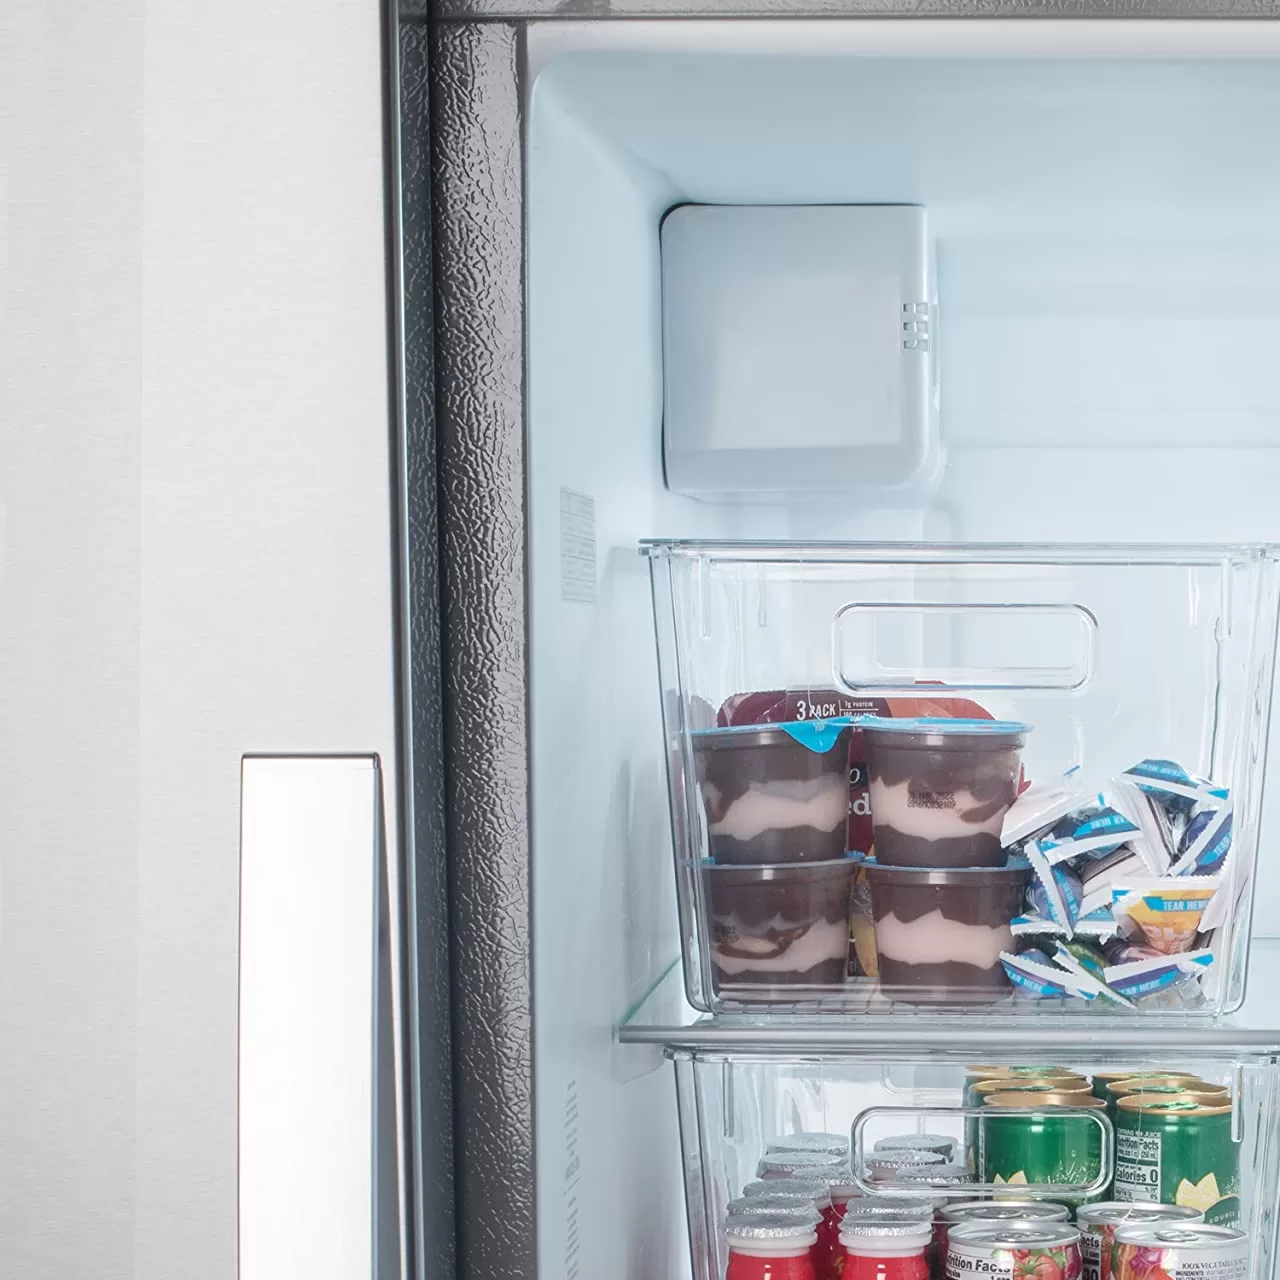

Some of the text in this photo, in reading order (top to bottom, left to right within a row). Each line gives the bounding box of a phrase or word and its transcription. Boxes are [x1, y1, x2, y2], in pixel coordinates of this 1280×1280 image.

[796, 700, 837, 721] 3 PACK
[1163, 900, 1184, 912] TEAR
[1116, 1168, 1158, 1183] Calories 0
